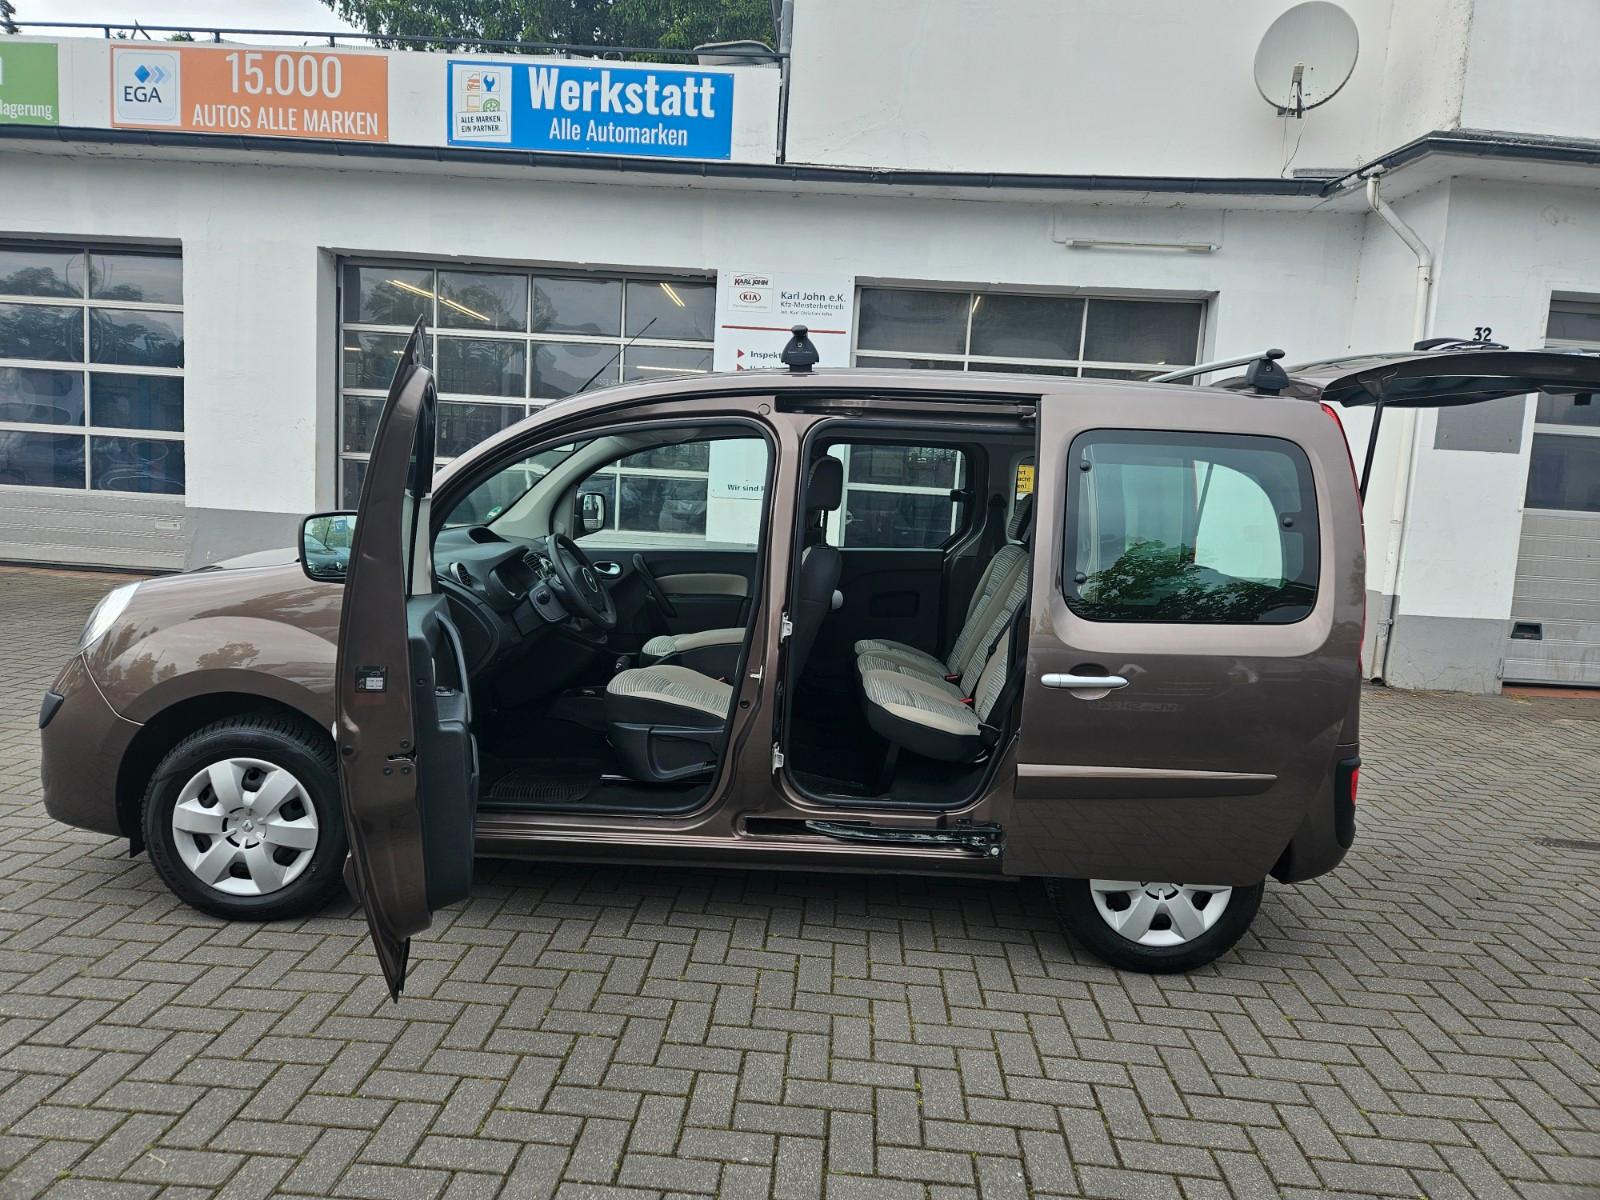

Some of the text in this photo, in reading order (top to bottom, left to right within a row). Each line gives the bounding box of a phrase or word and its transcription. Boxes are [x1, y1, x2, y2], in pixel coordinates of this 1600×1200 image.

[225, 52, 342, 98] 15.000
[124, 85, 162, 103] EGA
[527, 66, 716, 118] Werkstatt
[192, 103, 379, 135] AUTOS ALLE MARKEN
[460, 115, 474, 123] ALLE
[461, 125, 472, 133] EIN
[549, 117, 689, 146] Alle Automarken
[734, 278, 751, 286] KARL
[743, 293, 758, 301] KIA
[780, 291, 800, 300] Karl
[802, 292, 826, 301] John
[1472, 327, 1493, 342] 32
